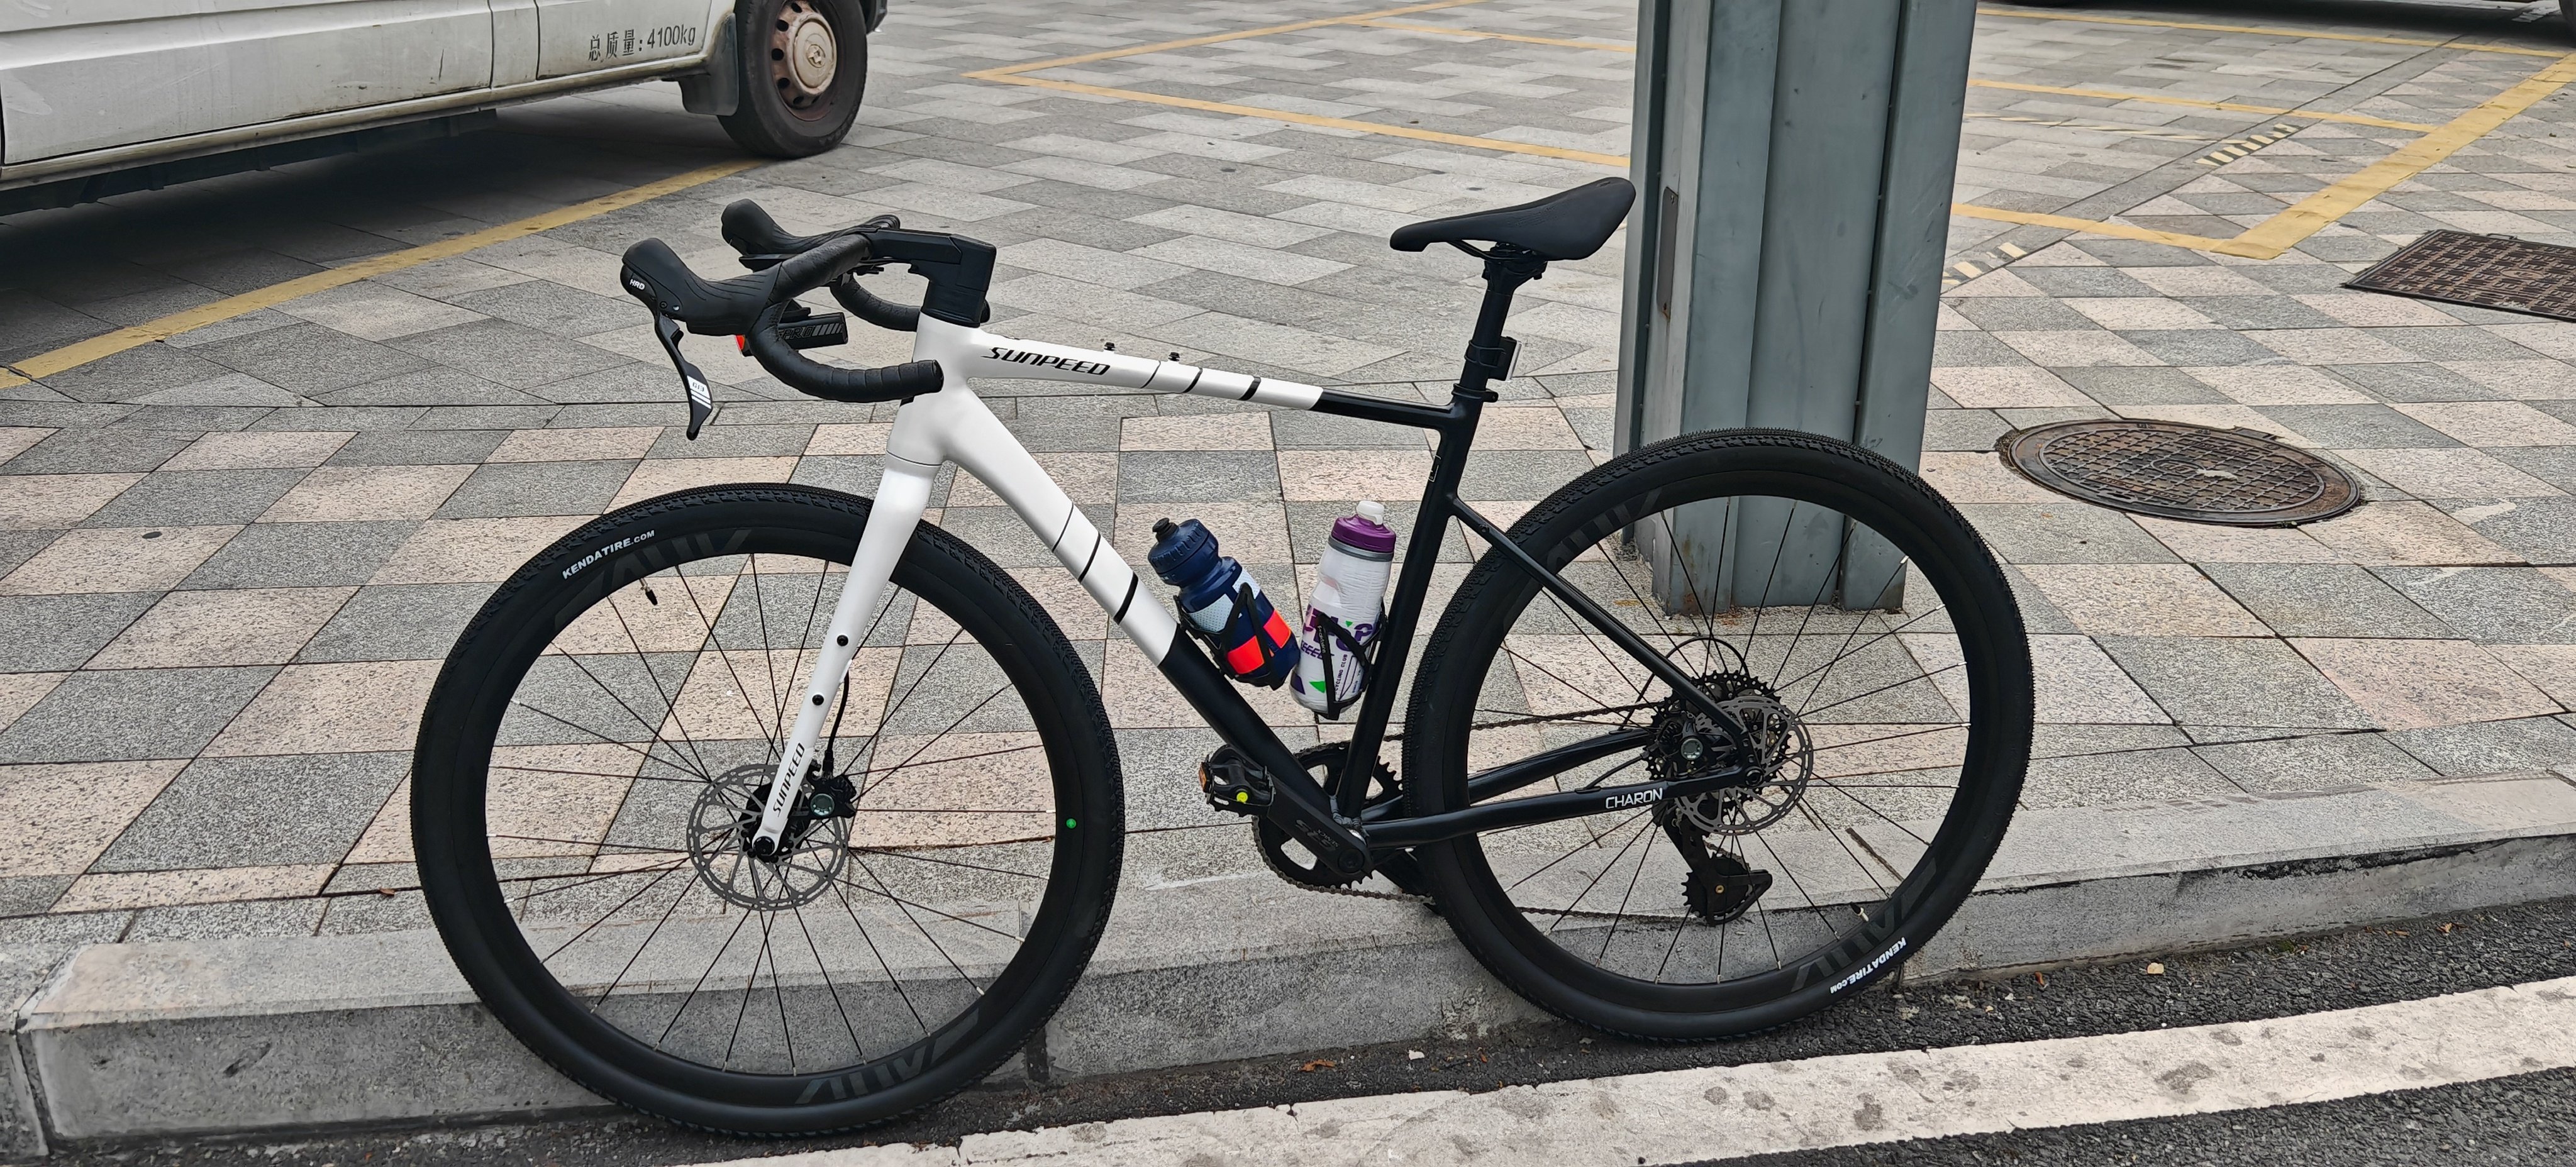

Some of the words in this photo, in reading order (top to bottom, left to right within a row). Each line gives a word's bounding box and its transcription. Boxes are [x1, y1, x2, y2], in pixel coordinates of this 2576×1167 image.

[630, 279, 645, 290] HRD
[981, 347, 1110, 375] SUNPEED
[562, 529, 655, 580] KENDATIRE.COM
[773, 743, 804, 817] SUNPEED
[1605, 787, 1663, 809] CHARON
[1830, 937, 1907, 994] KENDATIRE.COM
